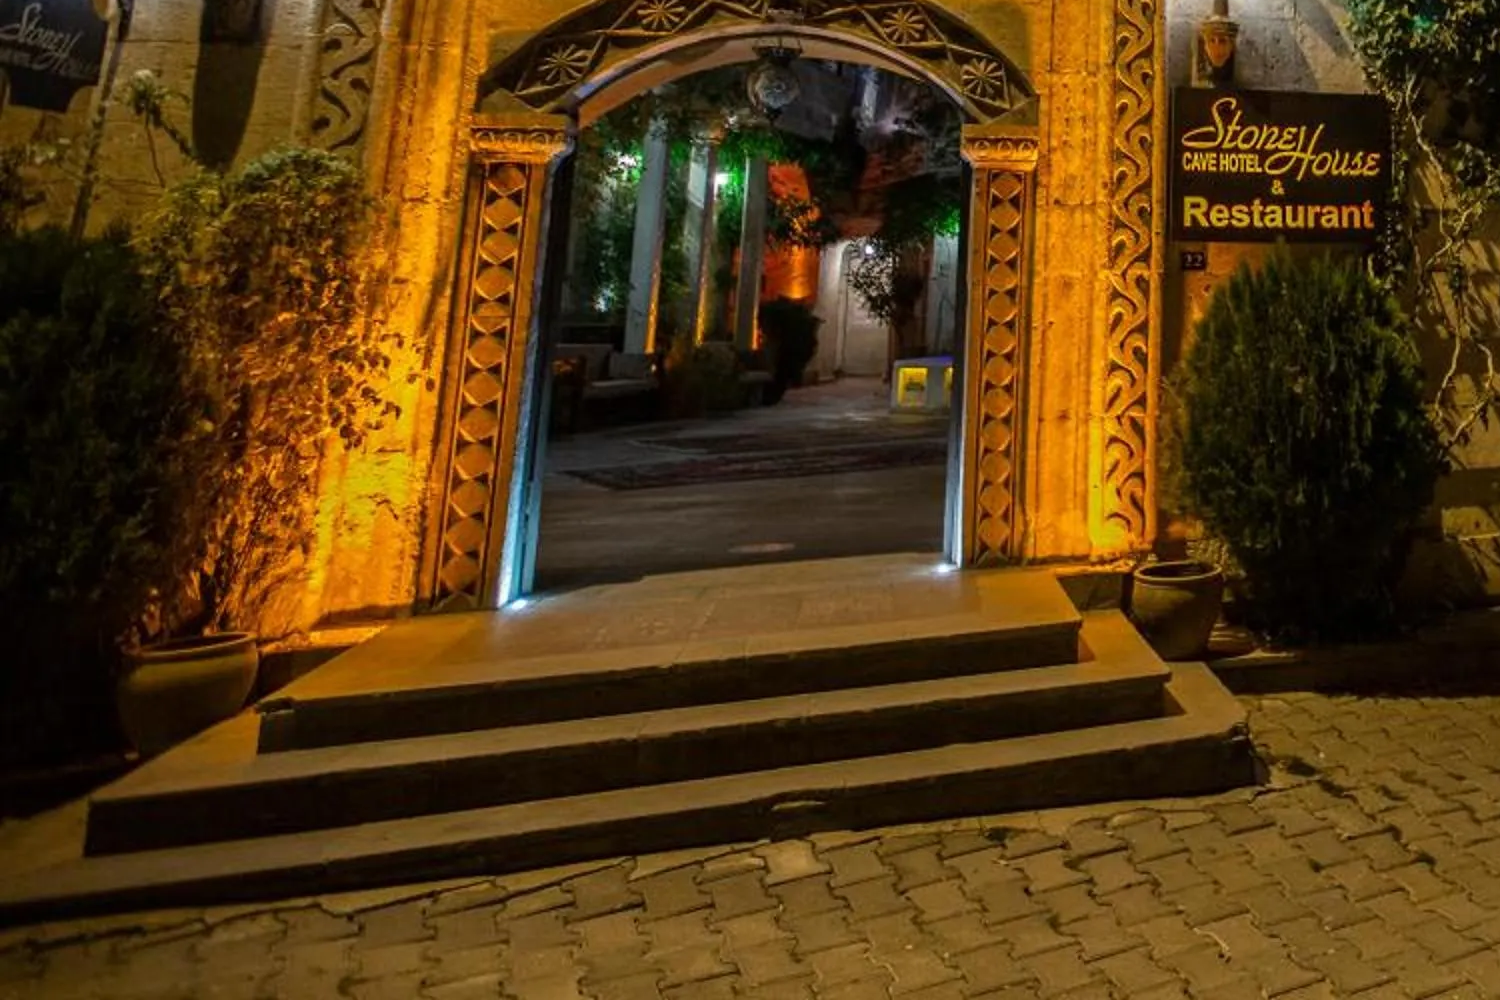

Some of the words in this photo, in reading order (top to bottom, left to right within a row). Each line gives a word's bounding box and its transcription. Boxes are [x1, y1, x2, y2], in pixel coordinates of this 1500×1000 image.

[1182, 152, 1217, 172] CAVE
[1219, 153, 1263, 173] HOTEL
[1271, 179, 1285, 195] &
[1183, 196, 1374, 229] Restaurant
